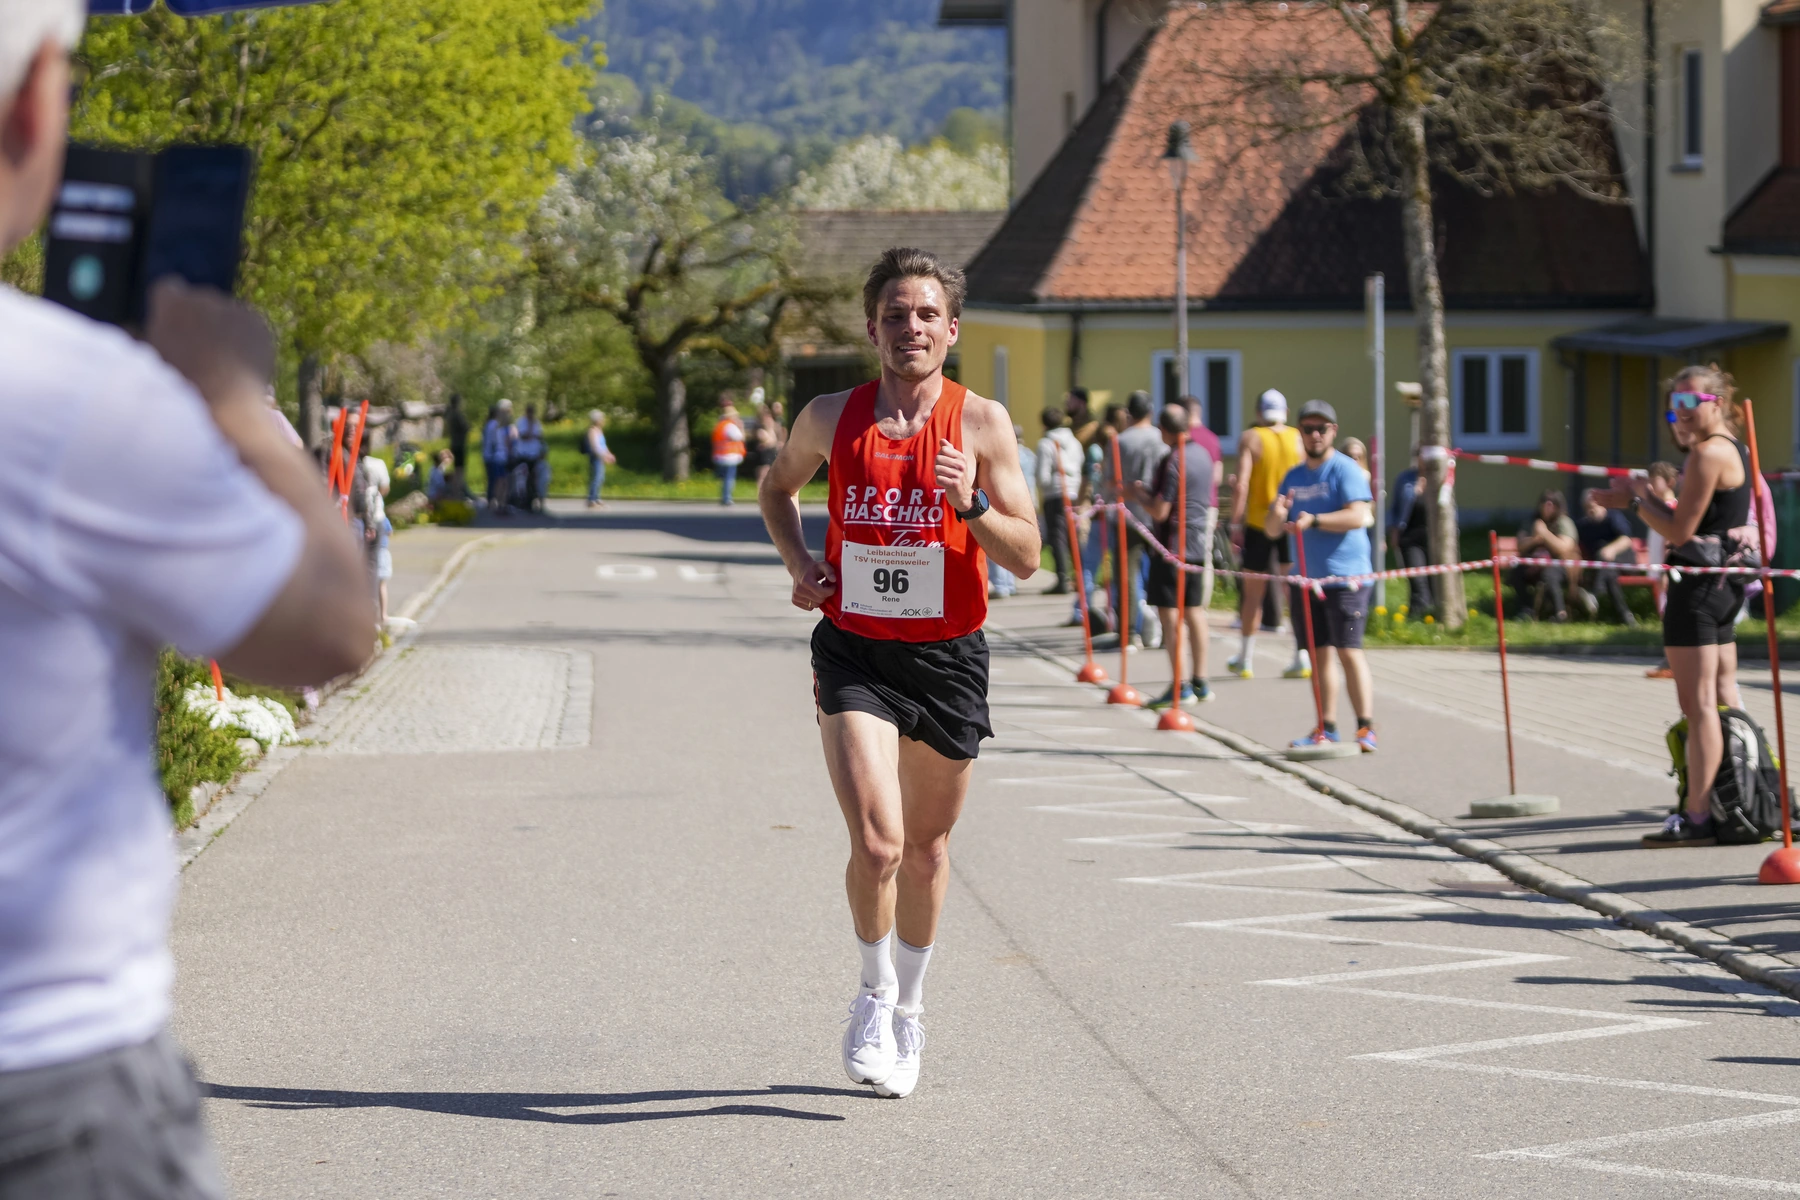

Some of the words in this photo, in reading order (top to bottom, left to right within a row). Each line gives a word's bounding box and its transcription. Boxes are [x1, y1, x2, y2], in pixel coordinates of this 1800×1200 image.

[875, 452, 914, 460] SALOMON
[846, 485, 945, 504] SPORT
[844, 503, 944, 522] HASCHKO
[867, 549, 916, 557] Leiblachlauf
[854, 556, 868, 564] TSV
[871, 557, 930, 566] Hergensweiler
[873, 568, 909, 594] 96
